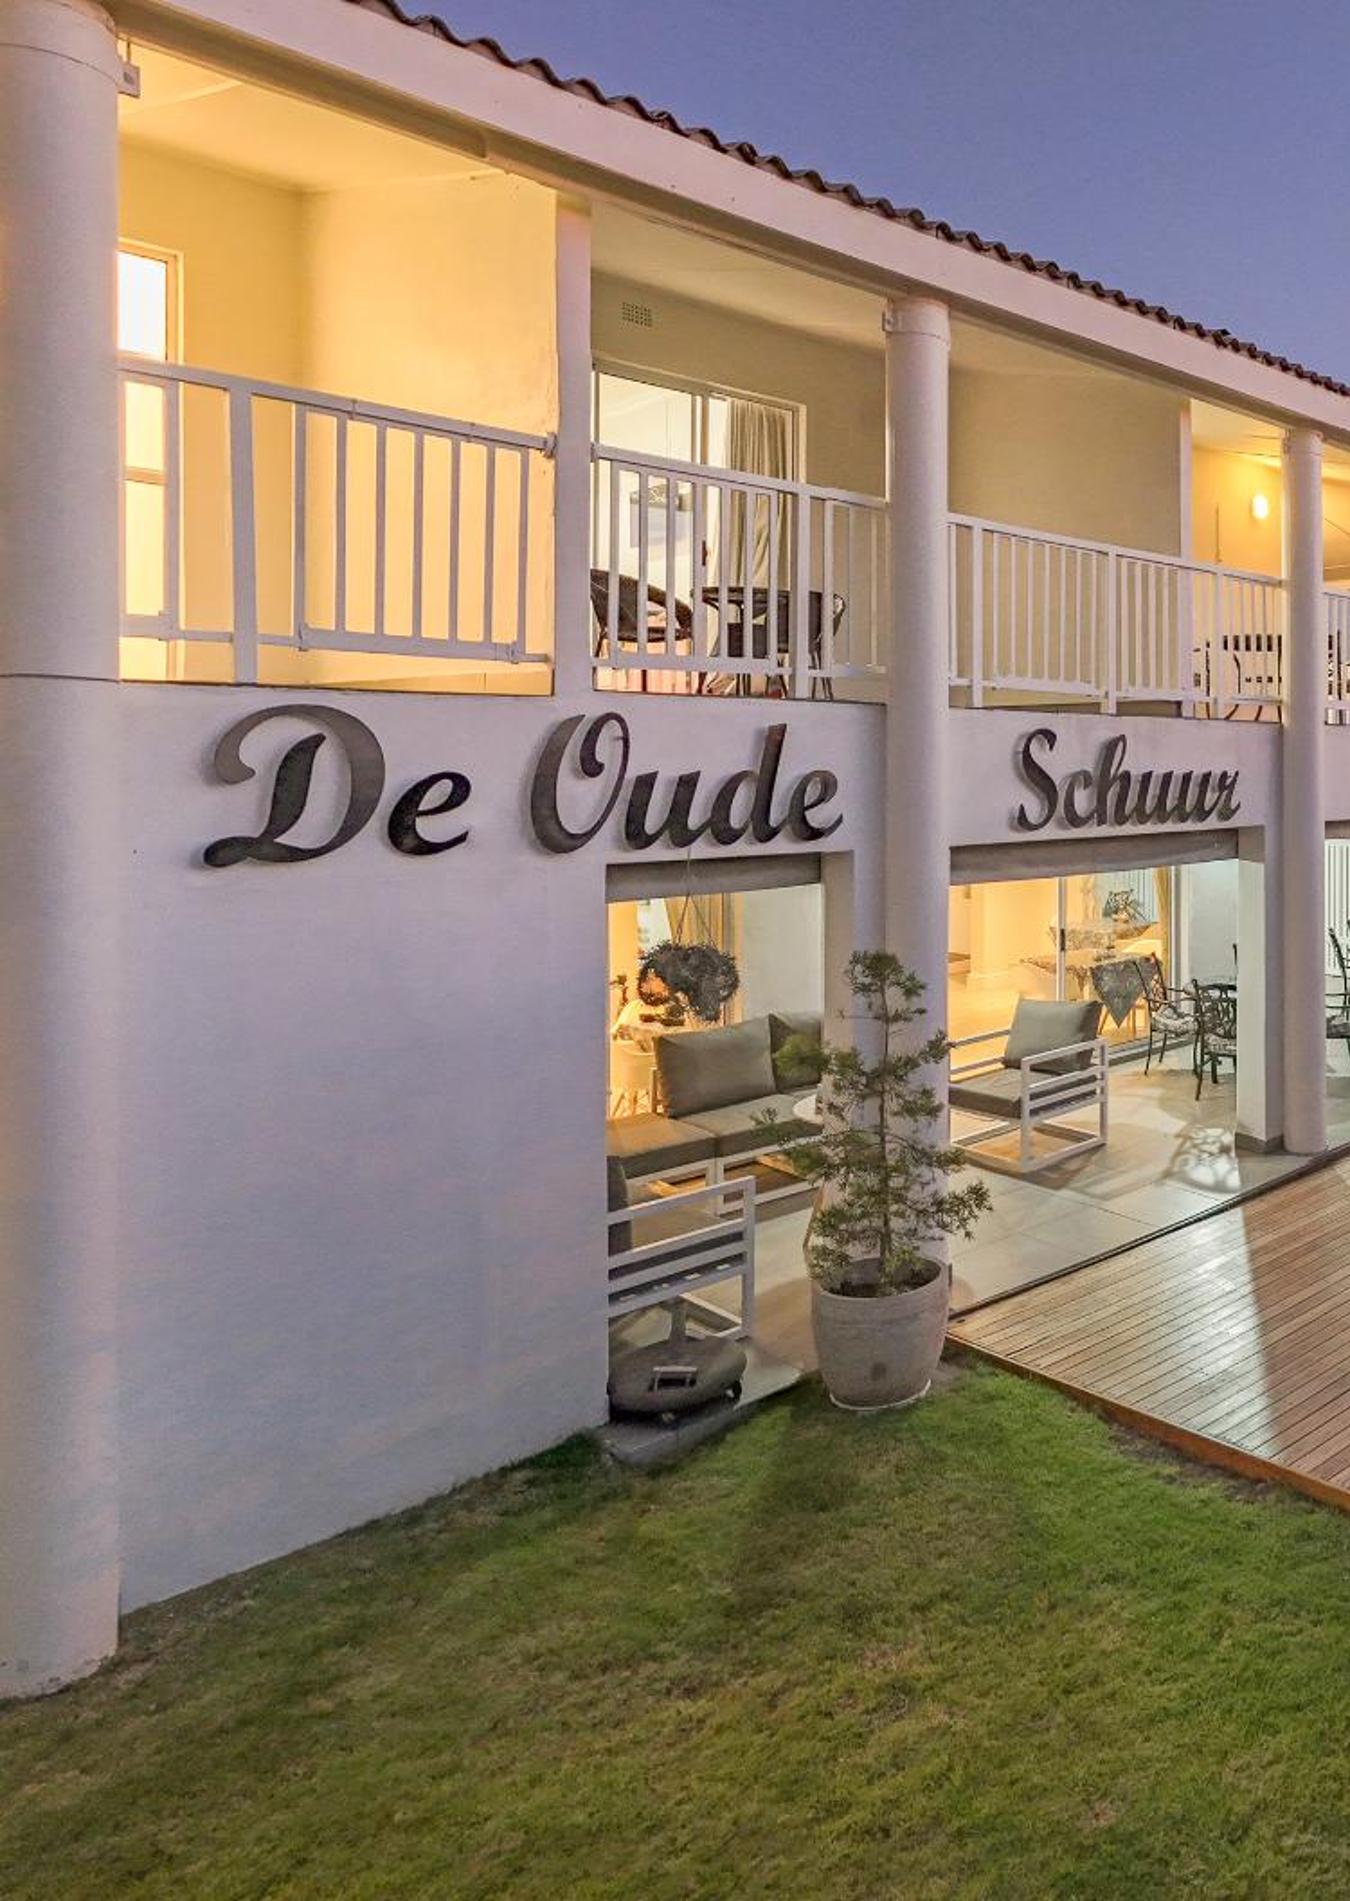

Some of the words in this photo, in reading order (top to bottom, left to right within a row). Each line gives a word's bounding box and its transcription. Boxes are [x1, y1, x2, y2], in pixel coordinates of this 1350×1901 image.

[203, 704, 472, 867] De
[530, 712, 844, 854] Oude
[1015, 727, 1241, 831] Schuur
